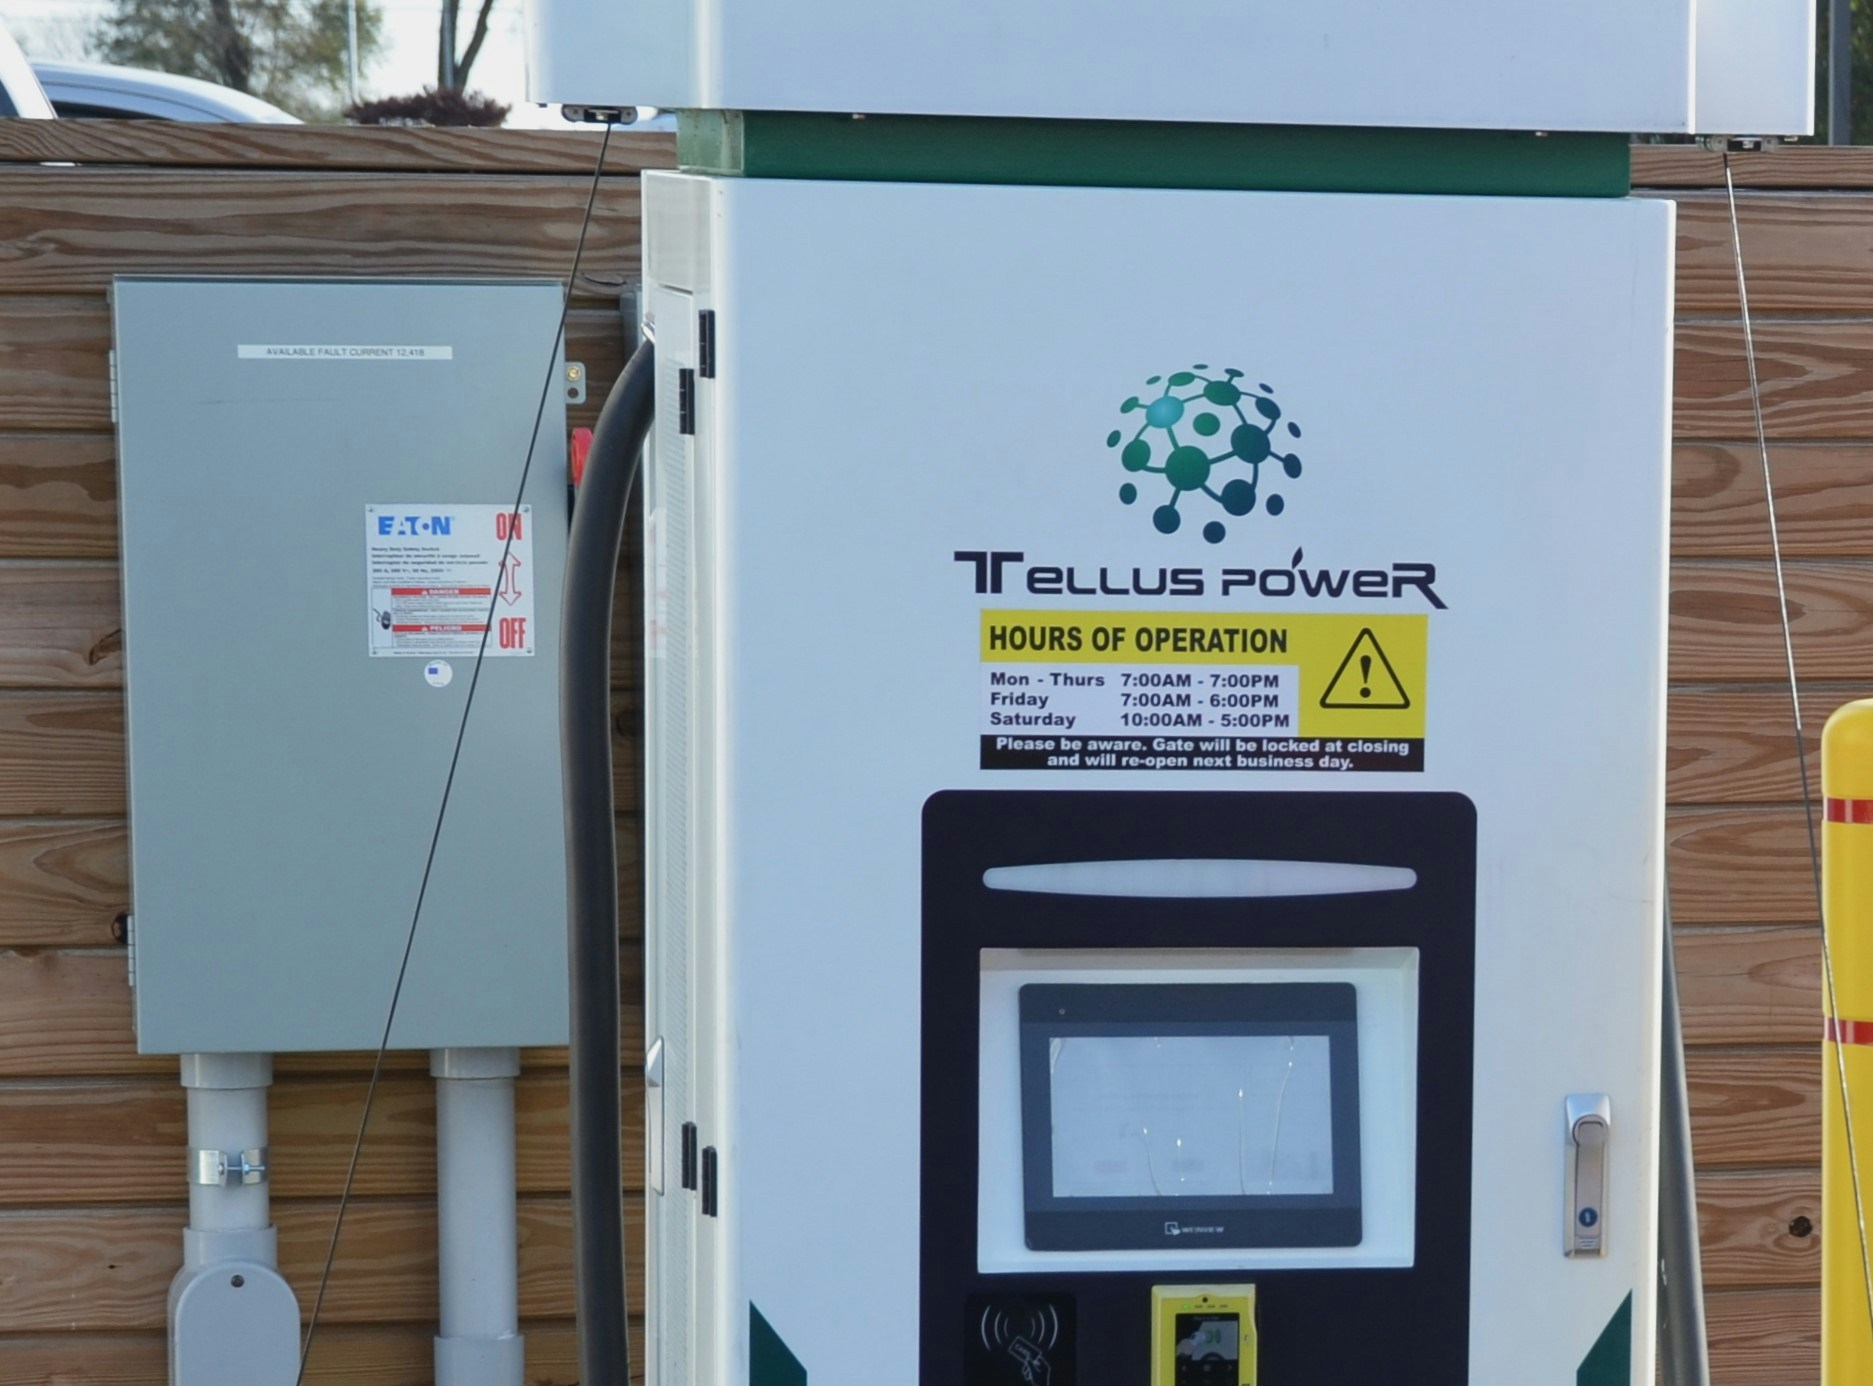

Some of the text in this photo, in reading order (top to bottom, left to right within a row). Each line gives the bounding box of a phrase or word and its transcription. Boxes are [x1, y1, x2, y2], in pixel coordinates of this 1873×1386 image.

[266, 348, 316, 356] AVAILABLE
[349, 349, 393, 357] CURRENT
[378, 516, 451, 535] EATON
[495, 512, 523, 541] ON
[499, 617, 527, 649] OFF
[989, 625, 1287, 653] HOURS OF OPERATION
[990, 672, 1030, 686] Mon
[1049, 673, 1105, 687] Thurs
[1120, 673, 1192, 688] 7:00AM
[1210, 674, 1279, 688] 7:00PM
[990, 692, 1049, 710] Friday
[1120, 693, 1192, 707] 7:00AM
[1209, 694, 1279, 708] 6:00PM
[990, 711, 1076, 730] Saturday
[1120, 713, 1203, 727] 10:00AM
[1220, 714, 1290, 728] 5:00PM
[996, 737, 1410, 756] Please be aware. Gate will be locked at closing
[1047, 754, 1354, 770] and will re-open next business day.
